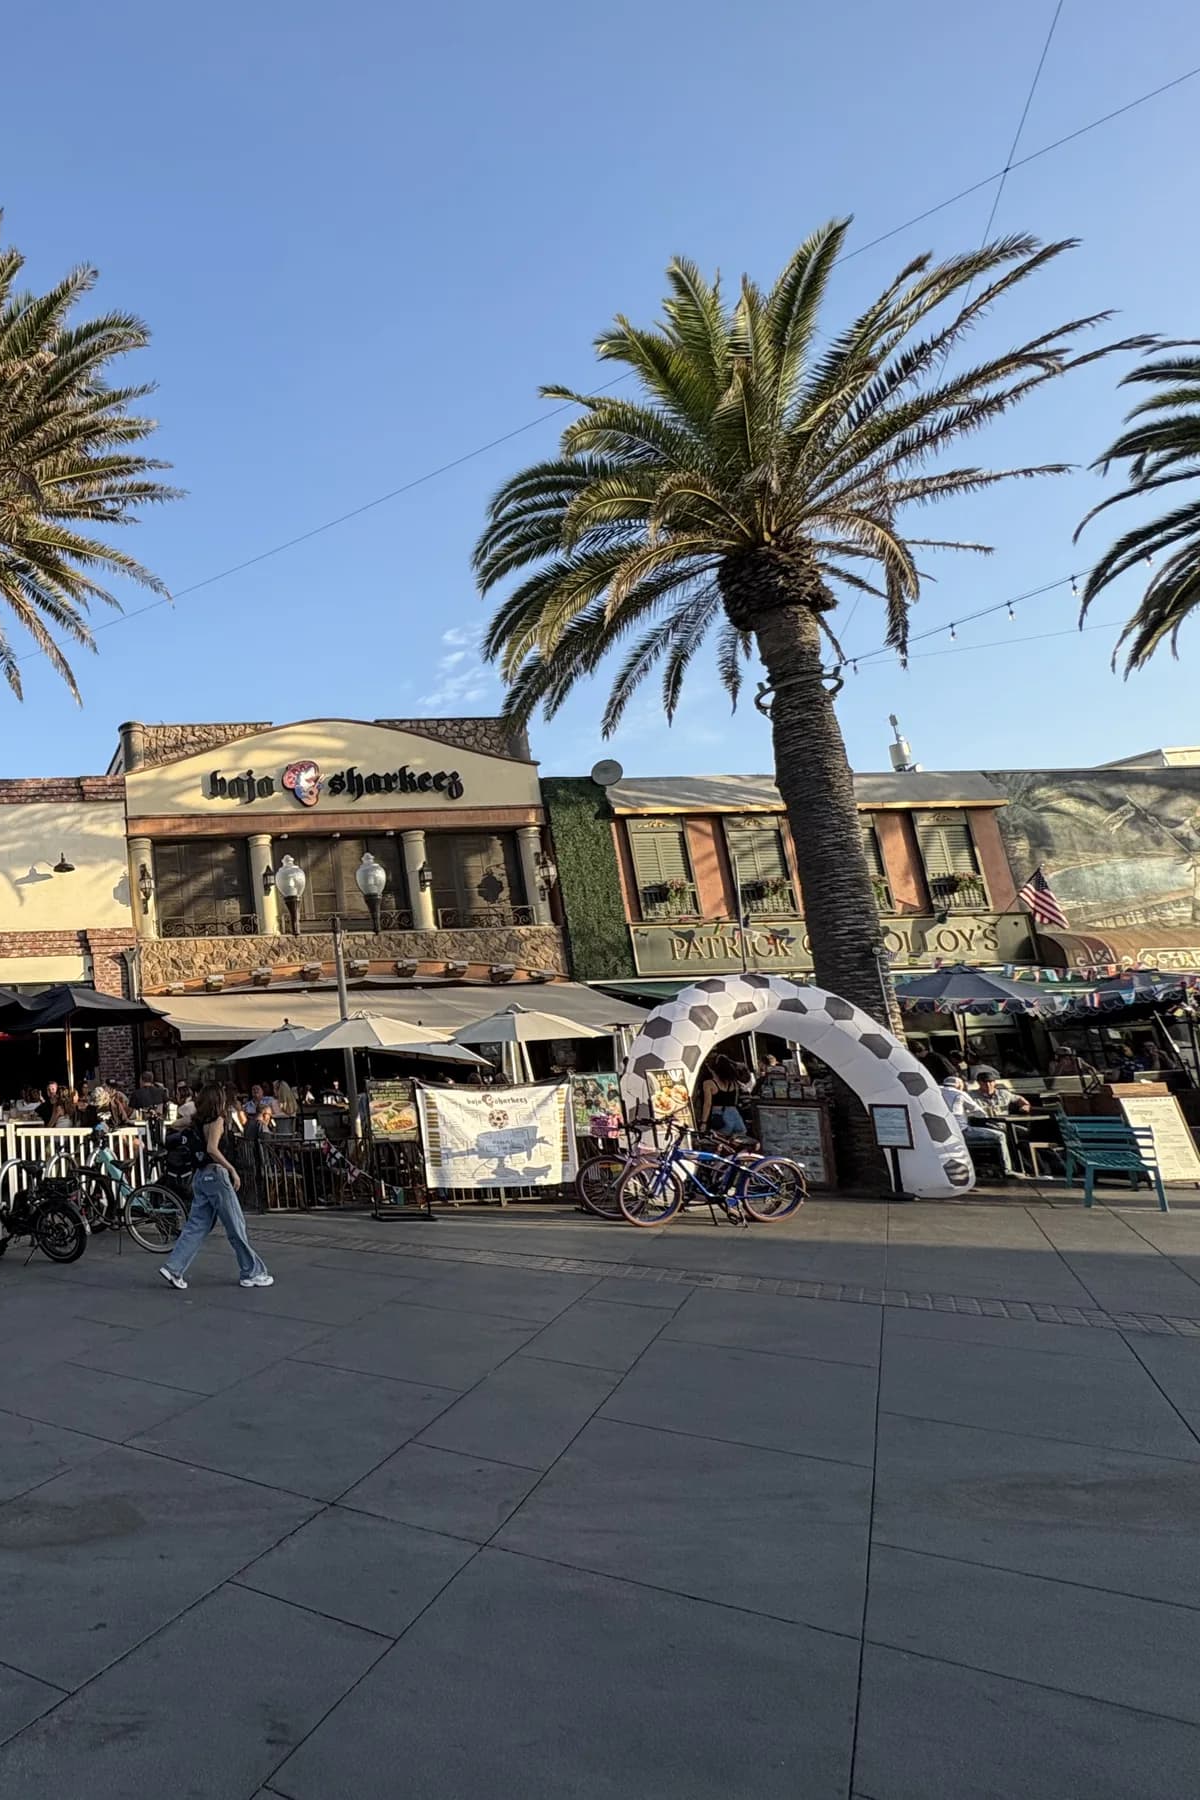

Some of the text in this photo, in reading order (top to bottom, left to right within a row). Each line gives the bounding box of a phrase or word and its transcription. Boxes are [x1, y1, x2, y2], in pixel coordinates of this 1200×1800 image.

[208, 765, 465, 805] baja sharkeez
[668, 935, 793, 961] PATRICK
